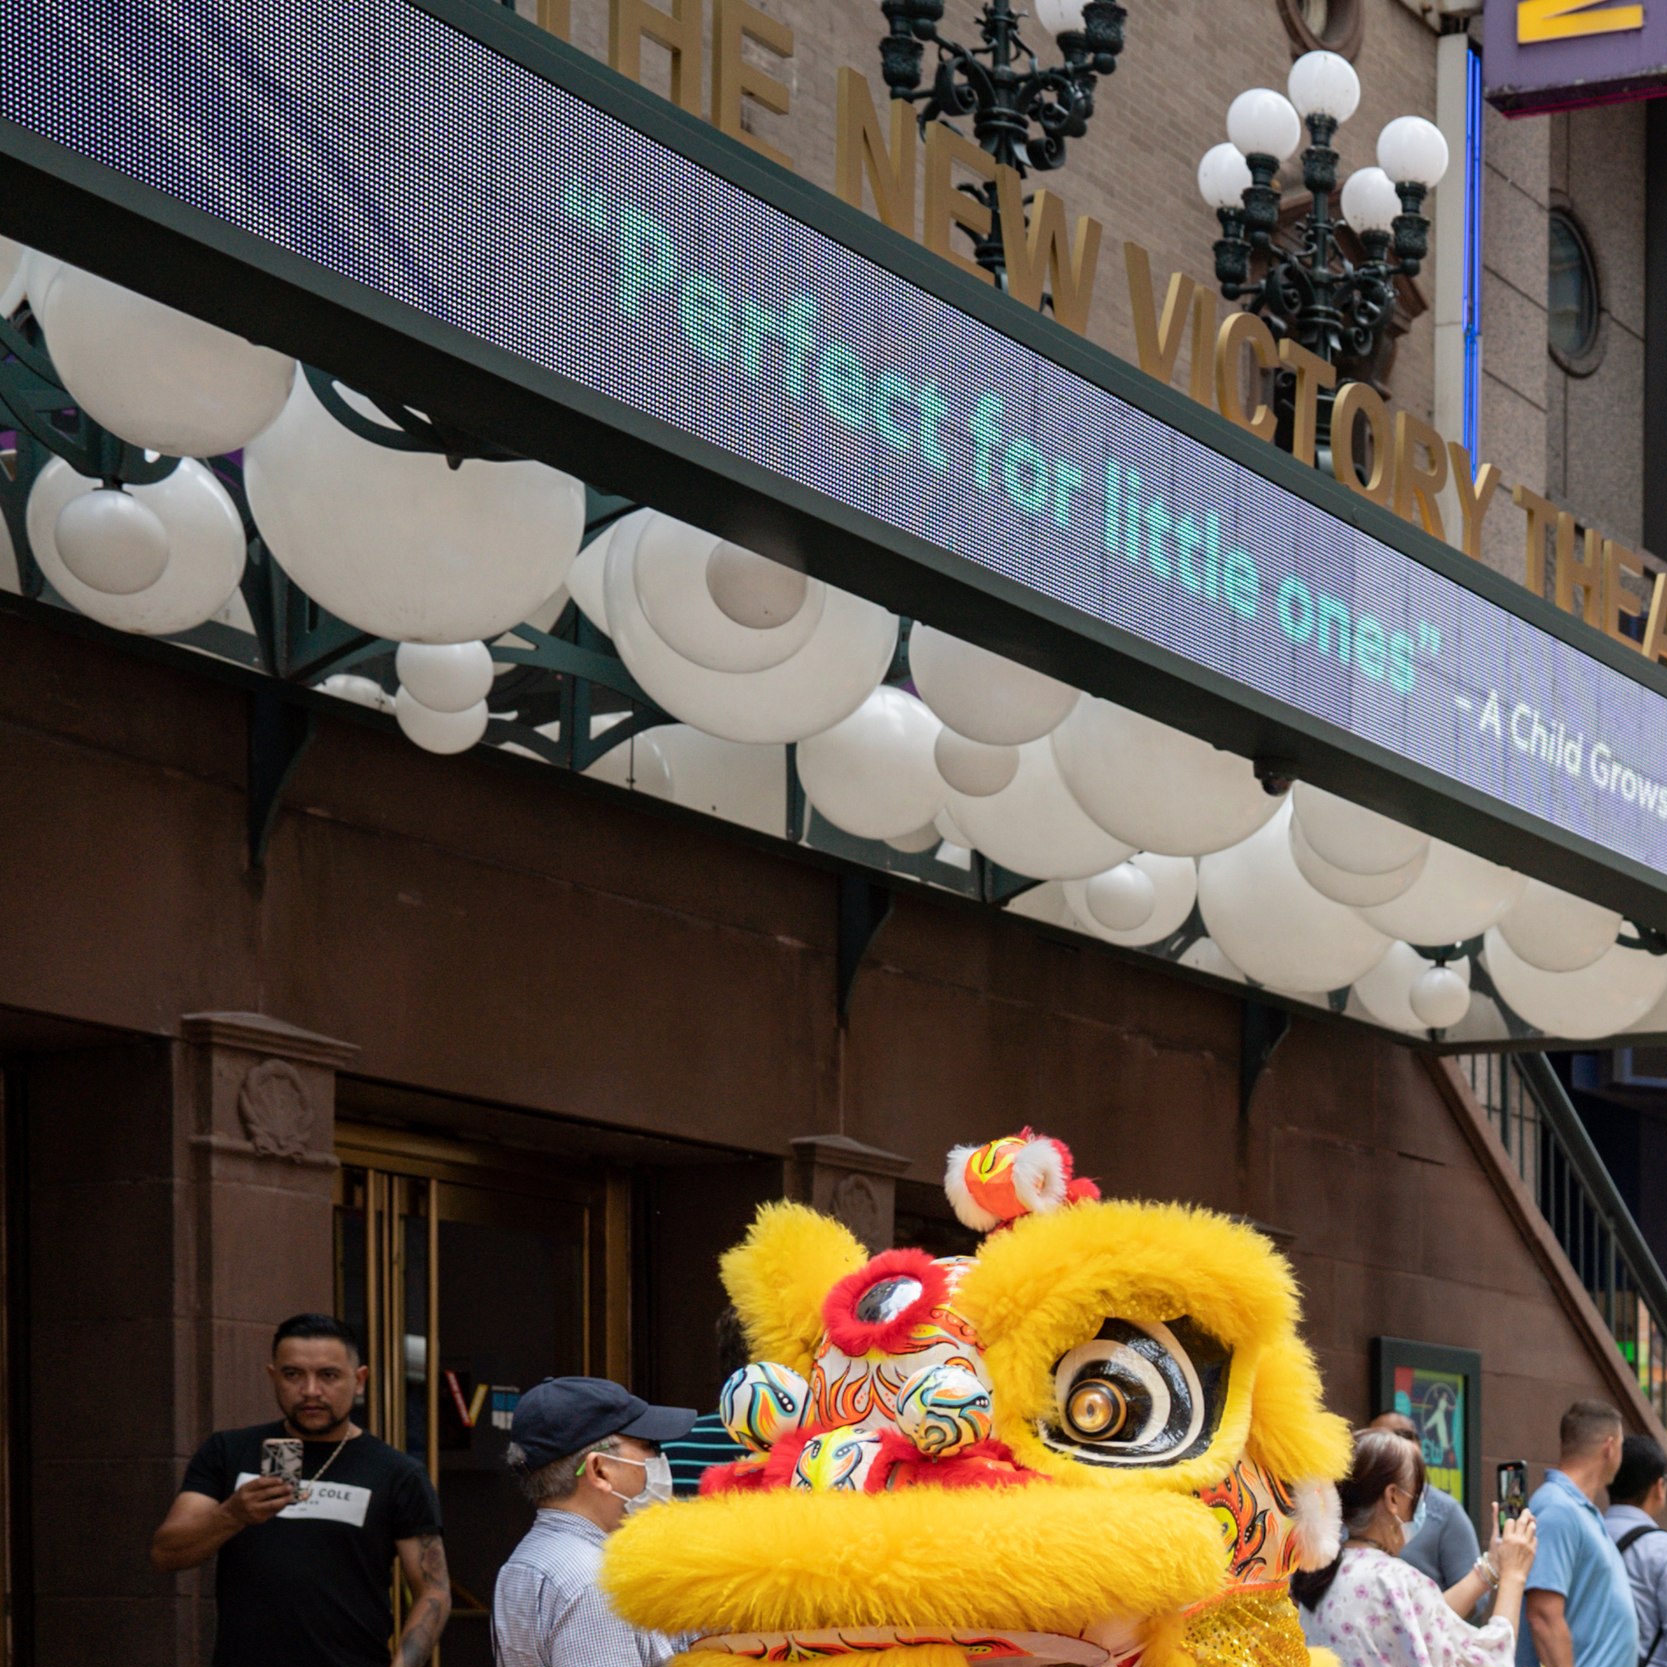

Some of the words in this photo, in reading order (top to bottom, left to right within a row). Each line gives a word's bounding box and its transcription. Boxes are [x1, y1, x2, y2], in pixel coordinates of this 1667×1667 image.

[537, 0, 794, 169] HE
[836, 67, 1102, 334] NEW
[1124, 241, 1500, 561] VICTORY
[969, 392, 1087, 528] for
[1103, 457, 1260, 619] little
[1479, 688, 1501, 740] A
[1511, 702, 1584, 778] Child
[318, 1488, 351, 1501] COLE
